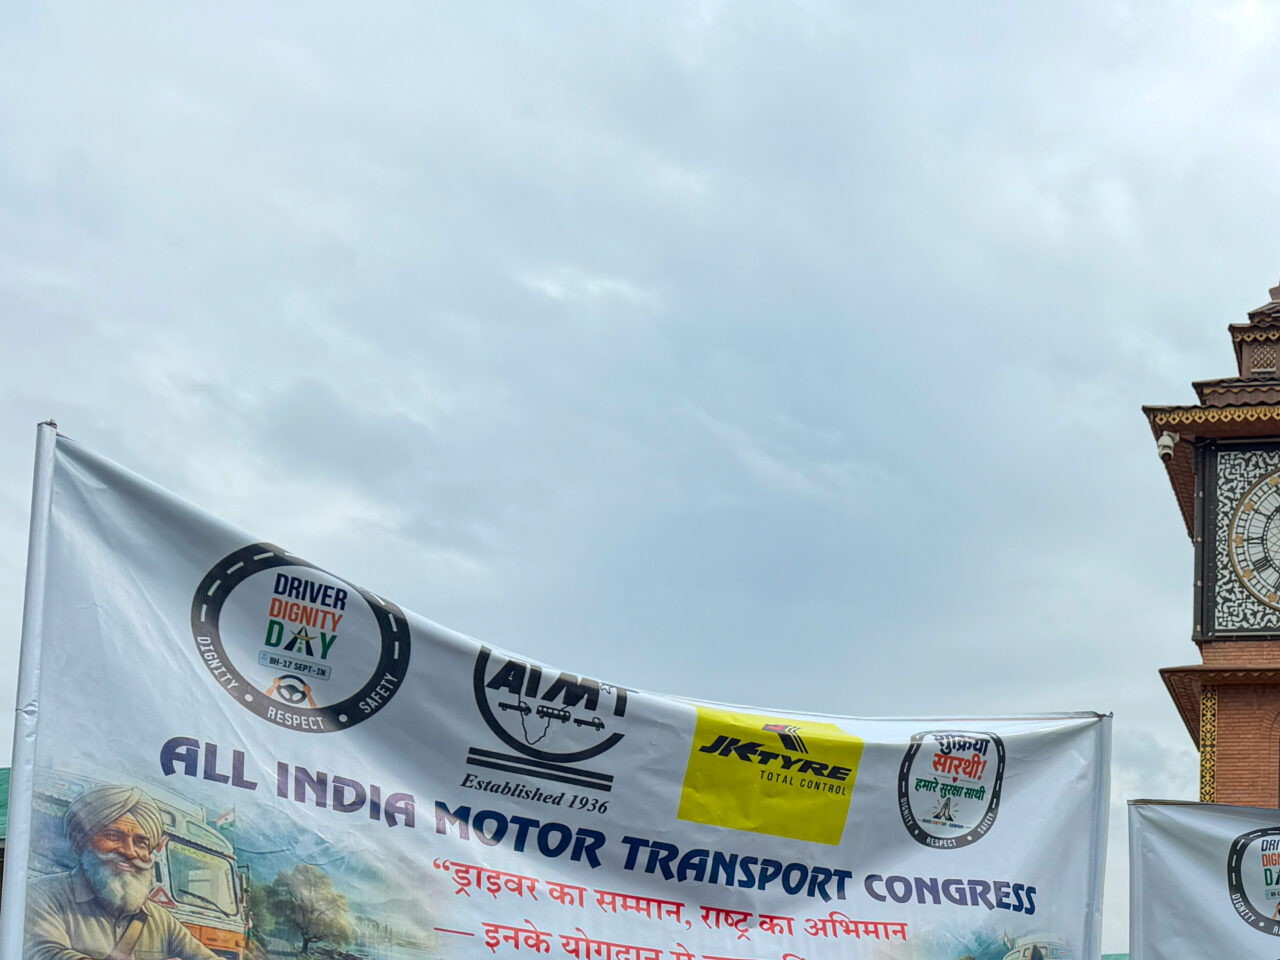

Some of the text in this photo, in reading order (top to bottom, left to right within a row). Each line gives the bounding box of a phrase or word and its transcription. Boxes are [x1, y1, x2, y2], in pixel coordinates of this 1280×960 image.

[273, 573, 348, 611] DRIVER
[269, 597, 343, 632] DIGNITY
[264, 619, 338, 660] DAY
[197, 635, 240, 689] DIGNITY
[269, 656, 293, 668] BH-17
[358, 672, 398, 714] SAFETY
[267, 706, 324, 730] RESPECT
[460, 772, 610, 814] Established 1936
[759, 770, 847, 796] TOTAL CONTROL
[914, 777, 986, 801] हमारे सुरक्षा साथी
[159, 735, 1037, 915] ALL INDIA MOTOR TRANSPORT CONGRESS
[900, 797, 913, 827] DIGNITY
[978, 812, 994, 834] SAFETY
[926, 836, 957, 847] RESPECT
[545, 880, 587, 908] का
[593, 889, 692, 930] सम्मान,
[699, 905, 752, 941] राष्ट्र
[758, 913, 794, 937] का
[804, 911, 908, 941] अभिमान
[1232, 892, 1257, 922] DIGNITY
[481, 918, 552, 954] इनके
